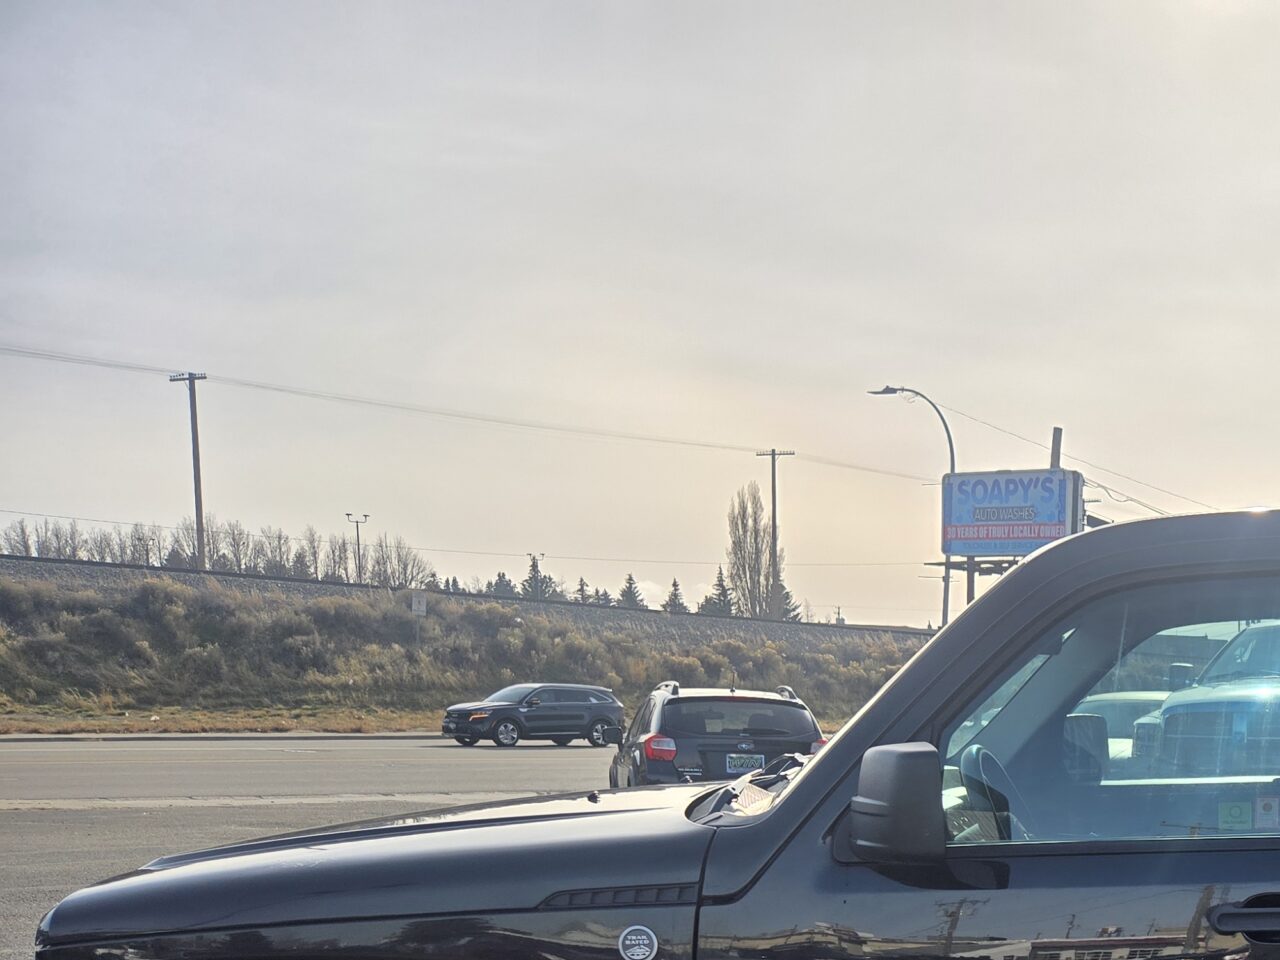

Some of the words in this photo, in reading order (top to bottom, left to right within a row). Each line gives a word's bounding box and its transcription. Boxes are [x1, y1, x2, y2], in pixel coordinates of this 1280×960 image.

[957, 477, 1055, 504] SOAPY'S
[975, 508, 998, 520] AUTO
[1000, 507, 1035, 520] WASHES
[957, 526, 978, 538] YEARS
[980, 526, 988, 538] OF
[1010, 525, 1040, 537] LOCALLY
[1040, 525, 1065, 537] OWNED
